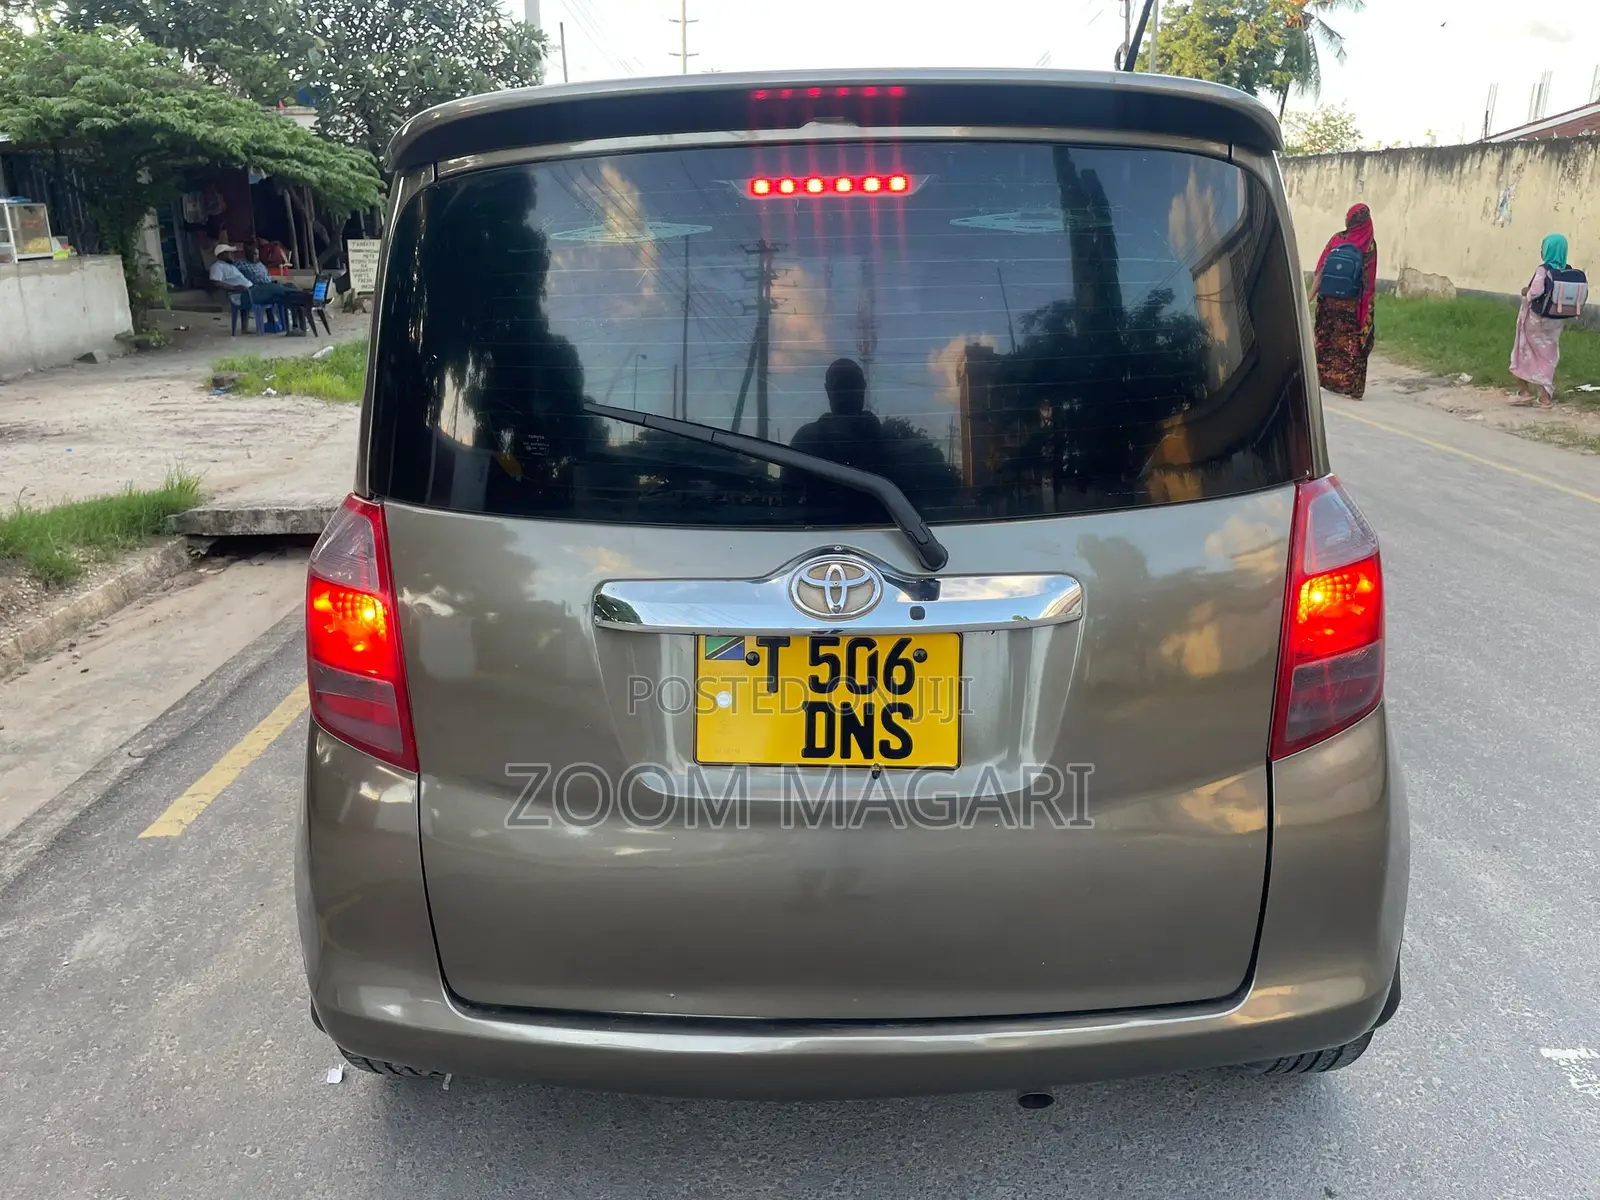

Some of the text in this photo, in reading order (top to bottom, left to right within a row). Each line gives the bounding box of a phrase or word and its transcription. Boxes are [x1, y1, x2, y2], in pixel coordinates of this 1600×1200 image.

[756, 636, 915, 695] T 506
[801, 700, 914, 760] DNS
